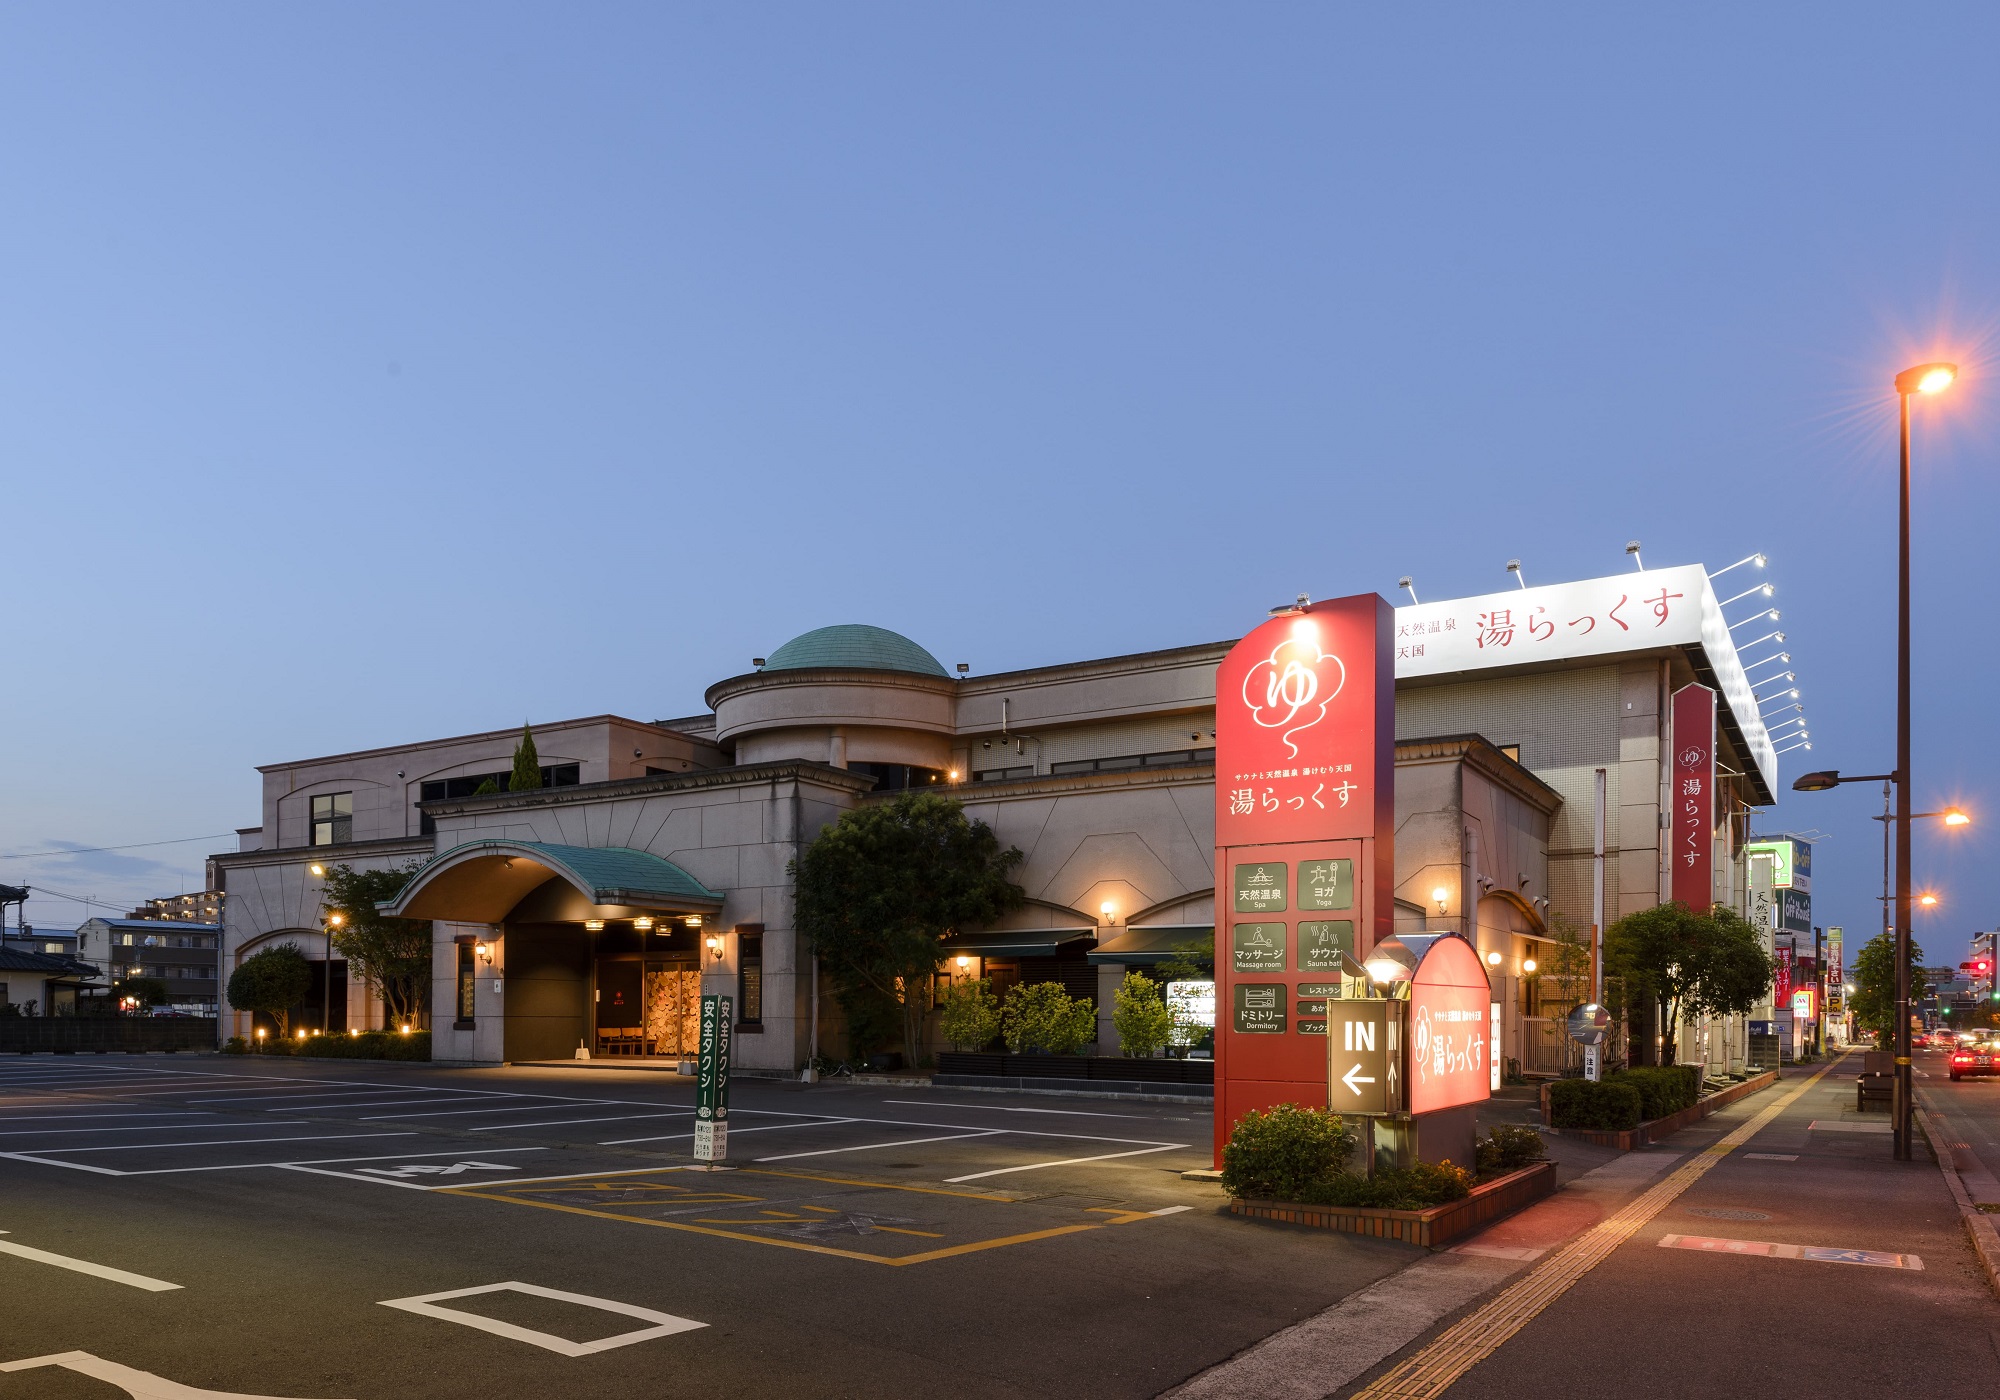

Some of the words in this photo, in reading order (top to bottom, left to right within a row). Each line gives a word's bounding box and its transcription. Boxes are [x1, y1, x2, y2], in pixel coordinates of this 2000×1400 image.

[1475, 587, 1684, 649] 湯らっくす
[1396, 617, 1457, 638] 天然温泉
[1396, 644, 1425, 660] 天国
[1266, 660, 1318, 710] ゆ
[1234, 767, 1299, 782] サウナと天然温泉
[1302, 763, 1353, 777] 湯けむり天国
[1229, 780, 1358, 815] 湯らっくす
[1682, 779, 1702, 868] 湯らっくす
[1239, 889, 1282, 901] 天然温泉
[1314, 886, 1335, 898] ヨガ
[1316, 899, 1332, 907] Yoga
[1235, 949, 1284, 960] マッサージ
[1310, 947, 1341, 959] サウナ
[1236, 961, 1265, 969] Massage
[1309, 986, 1341, 995] レストラン
[1311, 1004, 1328, 1013] あか
[1829, 998, 1840, 1007] P
[1241, 1010, 1284, 1021] ドミトリー
[1246, 1022, 1278, 1031] Dormitory
[1344, 1021, 1375, 1052] IN
[1388, 1021, 1397, 1051] IN
[701, 999, 715, 1106] 安全タクシー
[718, 1000, 731, 1106] 安全タクシー
[1432, 1032, 1484, 1076] 湯らっくす
[1586, 1057, 1594, 1075] 注意
